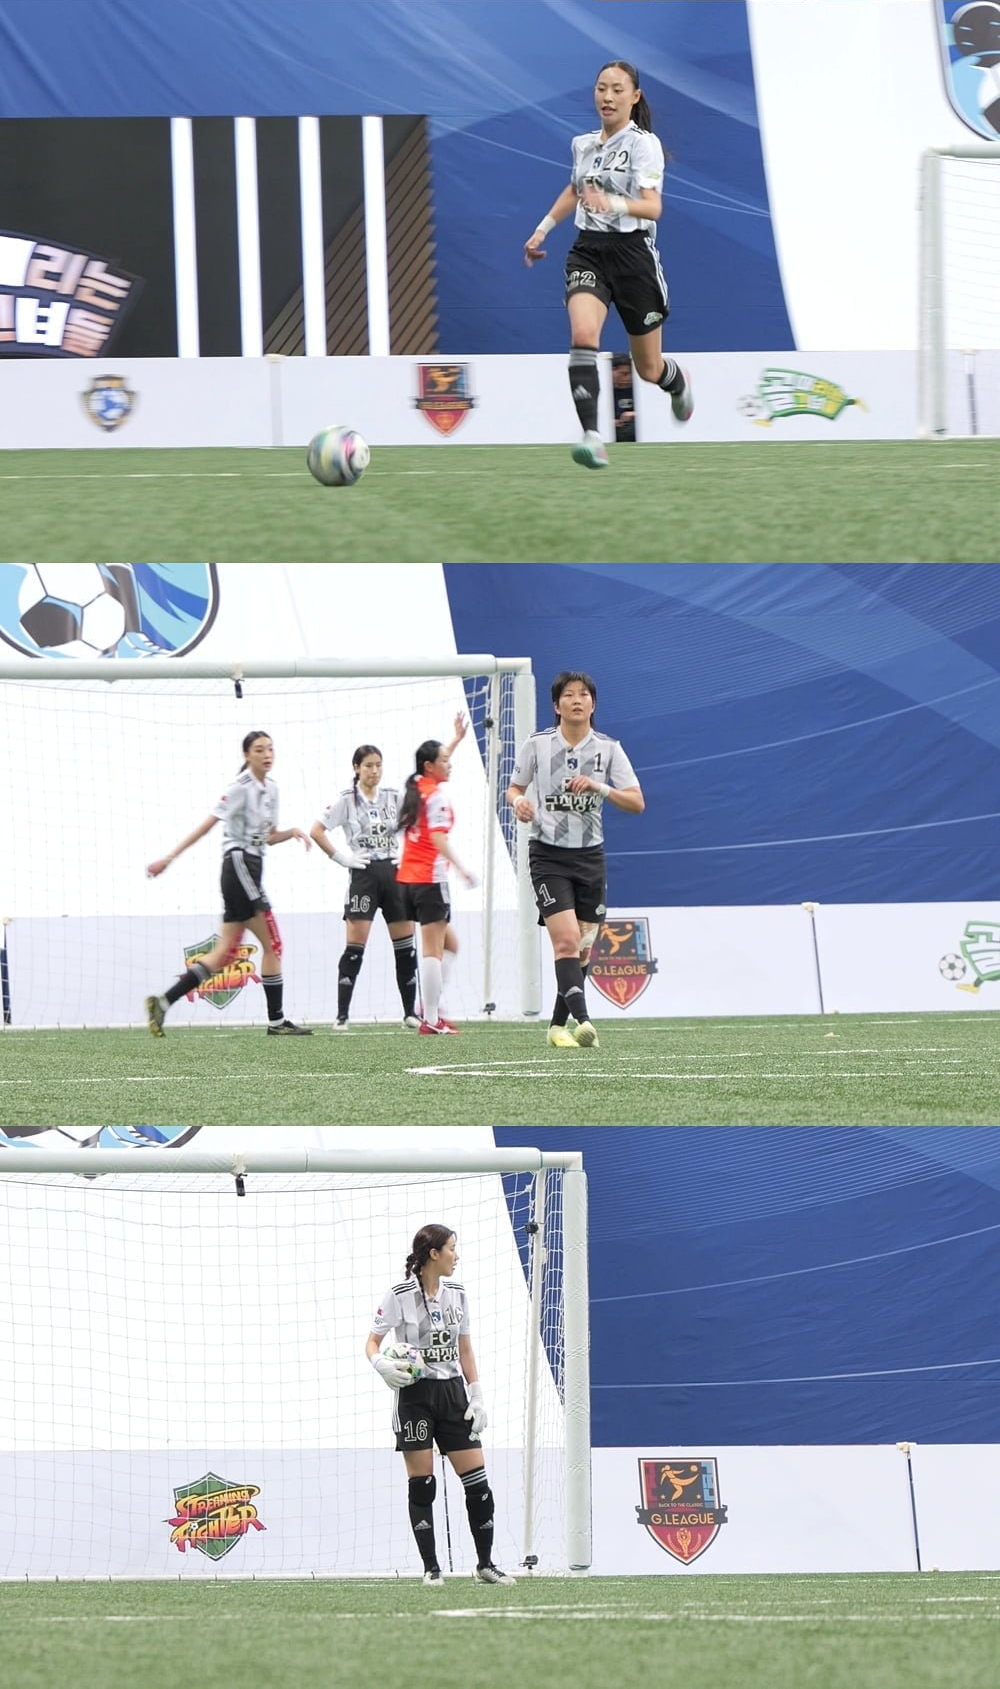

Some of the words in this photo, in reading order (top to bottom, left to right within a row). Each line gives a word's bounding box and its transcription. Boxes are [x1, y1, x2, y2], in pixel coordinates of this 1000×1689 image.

[602, 150, 629, 173] 22
[593, 752, 604, 773] 1
[350, 895, 371, 913] 16
[538, 883, 556, 907] 1
[592, 964, 647, 976] G.LEAGUE
[445, 1306, 464, 1325] 16
[430, 1330, 450, 1345] FC
[404, 1420, 428, 1442] 16
[176, 1485, 258, 1517] STREAMING
[171, 1504, 264, 1552] FIGHTER
[651, 1513, 715, 1525] G.LEAGUE
